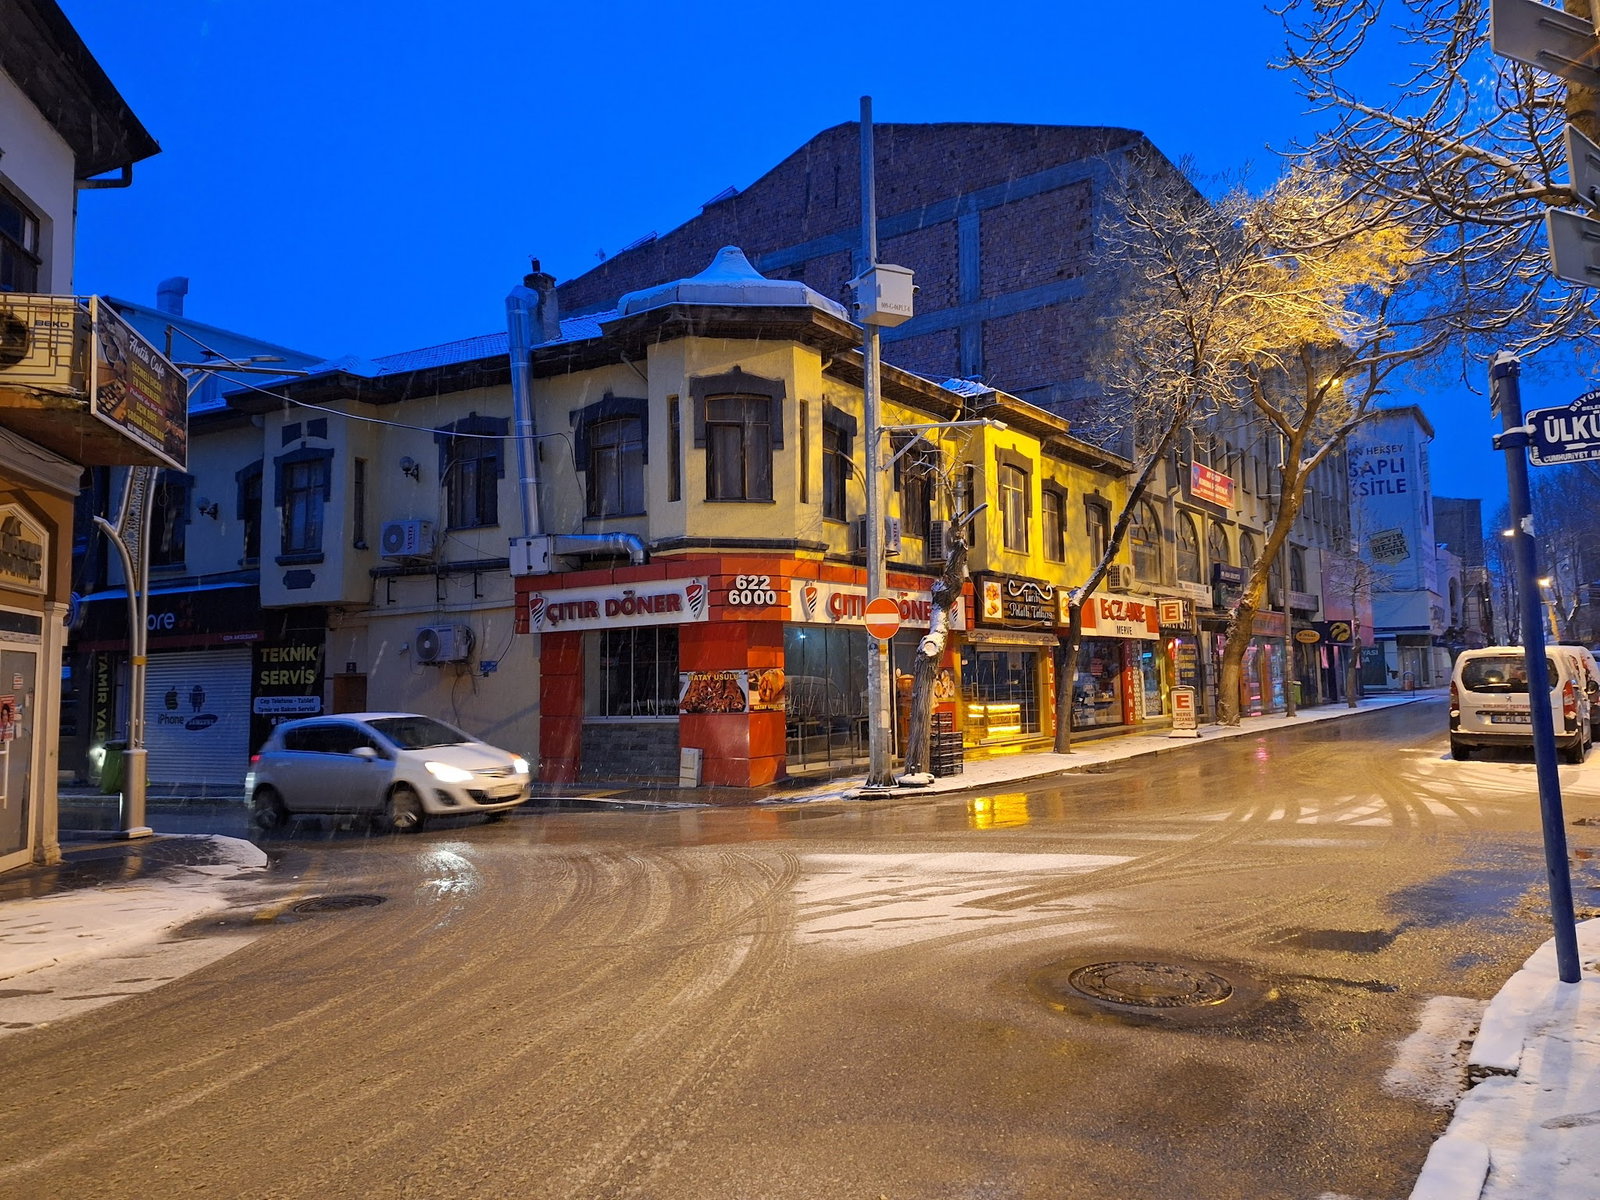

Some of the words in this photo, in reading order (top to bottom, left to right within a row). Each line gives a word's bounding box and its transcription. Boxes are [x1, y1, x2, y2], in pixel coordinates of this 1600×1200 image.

[128, 334, 150, 365] Antik
[1543, 450, 1589, 463] CUMHURİYET
[735, 574, 772, 590] 622
[728, 589, 777, 605] 6000
[829, 592, 868, 622] ÇITI
[888, 591, 932, 621] ÖNE
[546, 600, 600, 626] ÇITIR
[605, 589, 684, 617] DÖNER
[1100, 598, 1146, 622] ECZANE
[1164, 605, 1178, 620] E
[147, 611, 175, 631] ore
[1116, 625, 1133, 635] MERVE
[260, 643, 317, 663] TEKNİK
[97, 656, 110, 704] TAMİR
[260, 665, 316, 686] SERVİS
[1125, 644, 1134, 722] ECZANE
[1176, 694, 1190, 709] E
[158, 713, 185, 725] iPhone
